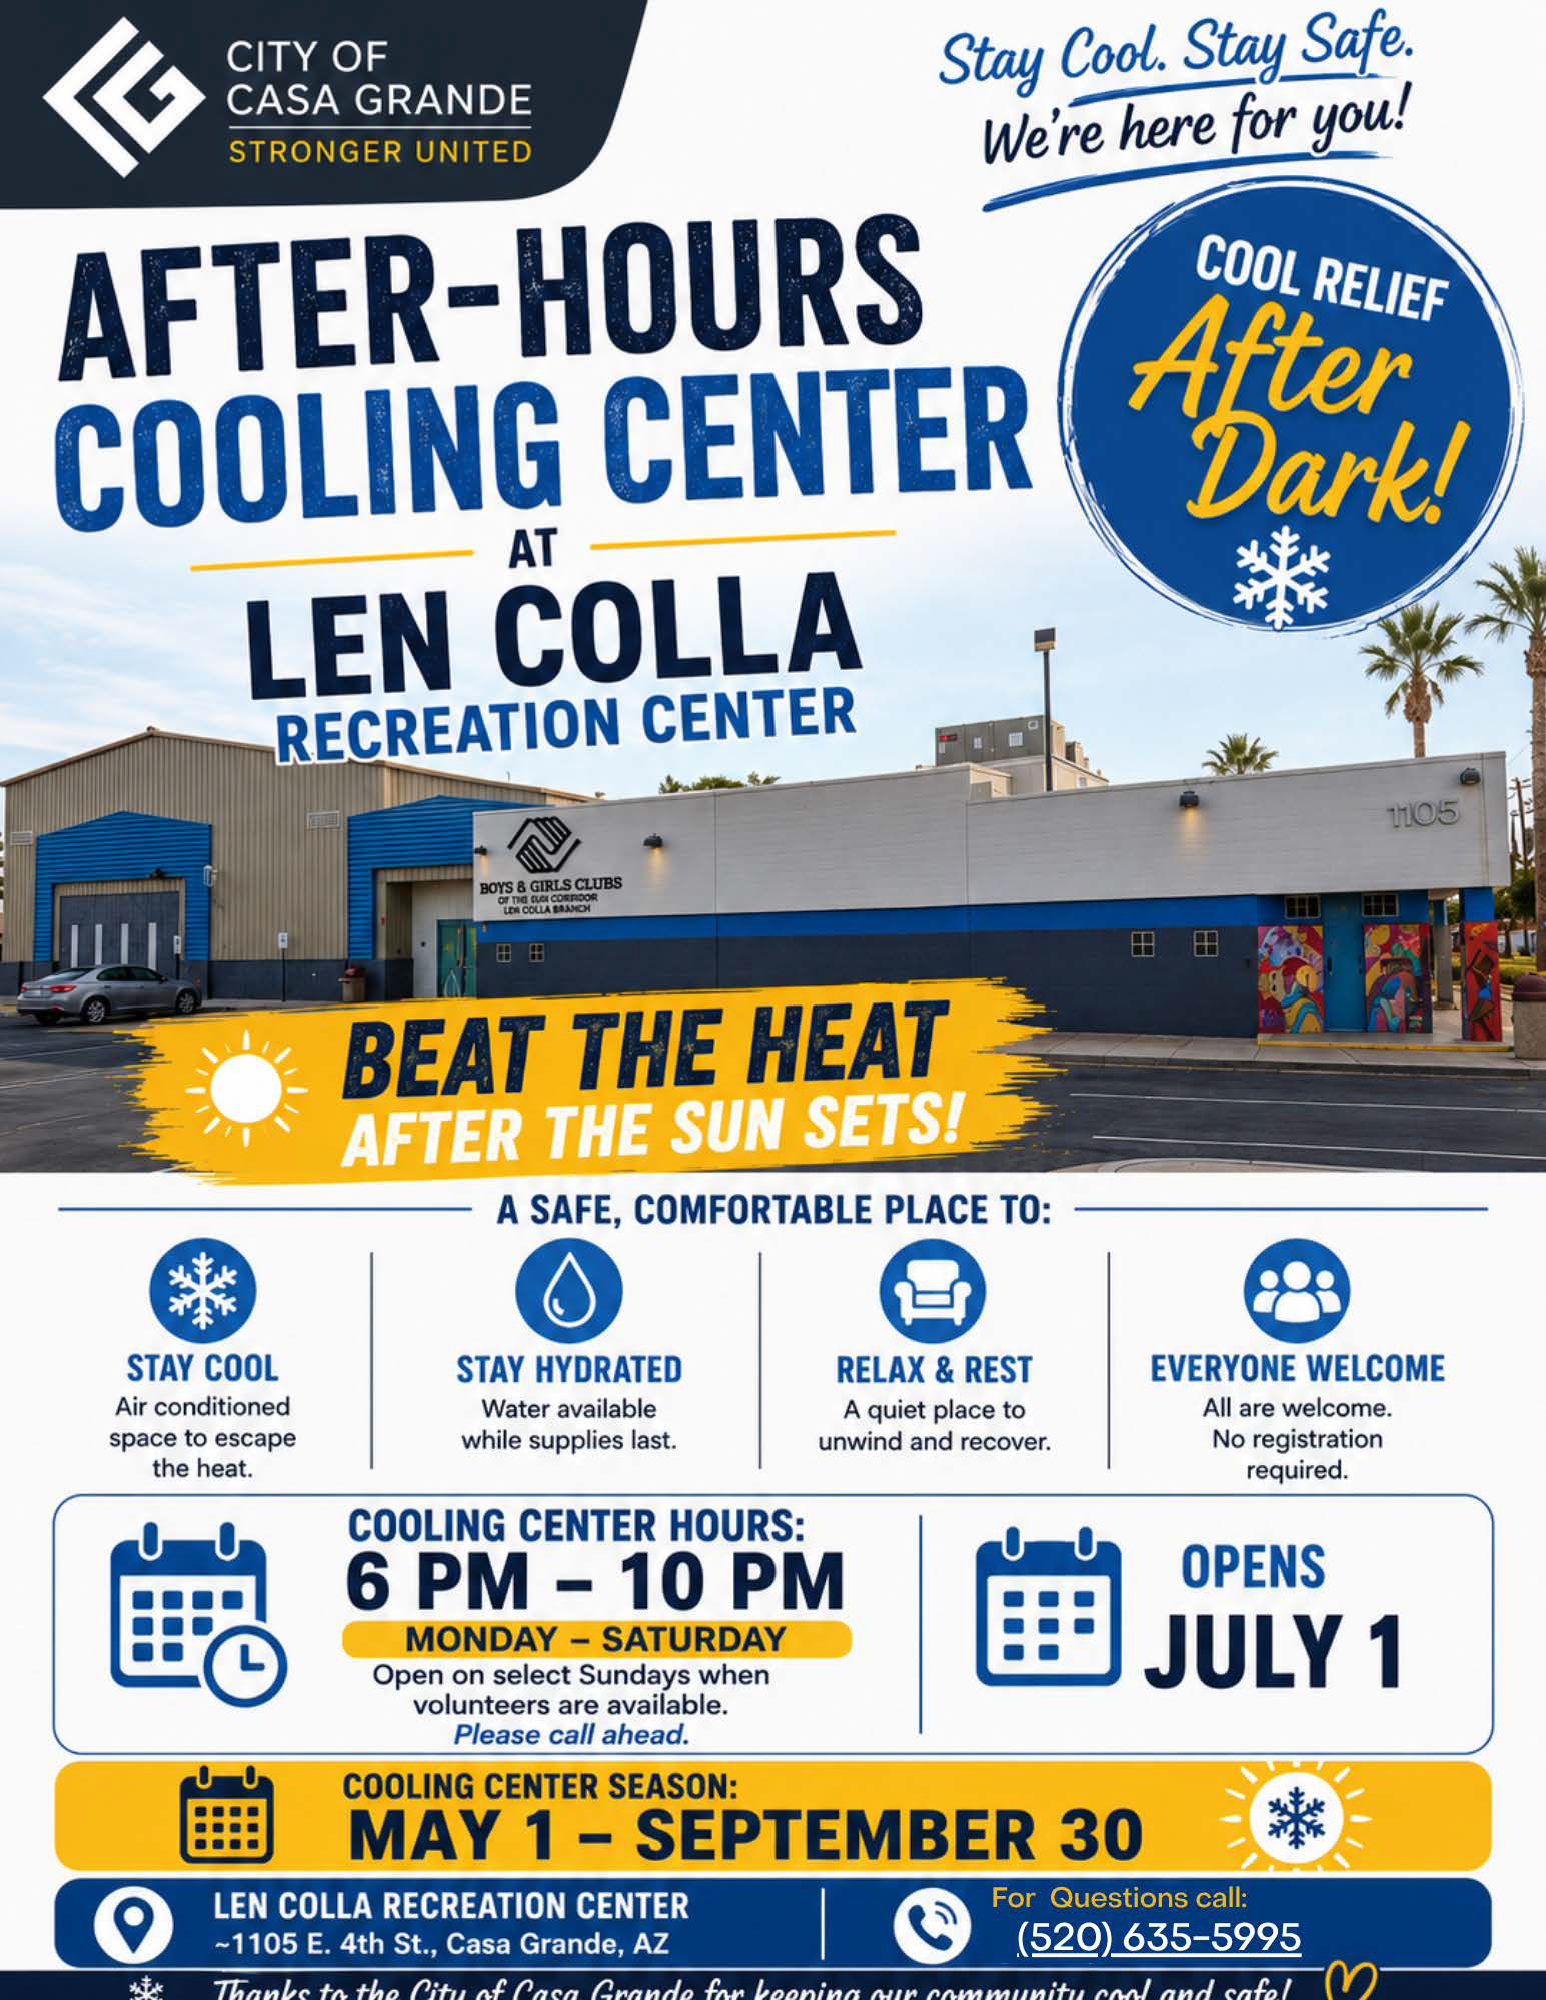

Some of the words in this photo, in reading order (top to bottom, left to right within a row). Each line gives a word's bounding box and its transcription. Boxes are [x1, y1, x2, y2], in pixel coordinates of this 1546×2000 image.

[226, 40, 318, 73] CITY
[332, 40, 388, 73] OF
[939, 33, 1044, 97] Stay
[1060, 23, 1166, 76] Cool.
[1183, 19, 1286, 82] Stay
[1302, 8, 1414, 76] Safe.
[226, 83, 340, 116] CASA
[355, 83, 532, 116] GRANDE
[1119, 103, 1217, 150] here
[1231, 92, 1297, 154] for
[1312, 82, 1413, 154] you!
[229, 139, 401, 163] STRONGER
[416, 139, 532, 163] UNITED
[1195, 233, 1301, 297] COOL
[1314, 258, 1450, 322] RELIEF
[57, 213, 924, 382] AFTER-HOURS
[1128, 293, 1413, 420] After
[54, 380, 562, 533] COOLING
[602, 366, 1034, 505] CENTER
[1186, 409, 1471, 524] Dark!
[508, 527, 558, 569] AT
[246, 590, 452, 701] LEN
[494, 571, 864, 688] COLLA
[277, 697, 620, 763] RECREATION
[643, 685, 857, 744] CENTER
[1387, 799, 1461, 829] 1105
[480, 881, 513, 895] BOYS
[517, 880, 526, 893] &
[530, 879, 572, 892] GIRLS
[575, 876, 623, 890] CLUBS
[341, 1014, 547, 1100] BEAT
[572, 1008, 722, 1091] THE
[746, 999, 951, 1084] HEAT
[339, 1108, 525, 1168] AFTER
[545, 1103, 652, 1158] THE
[669, 1098, 791, 1154] SUN
[803, 1090, 967, 1149] SETS!
[496, 1194, 519, 1225] A
[530, 1193, 621, 1230] SAFE,
[634, 1193, 873, 1225] COMFORTABLE
[885, 1193, 988, 1225] PLACE
[999, 1193, 1051, 1225] TO:
[127, 1353, 194, 1382] STAY
[204, 1353, 279, 1382] COOL
[456, 1354, 525, 1384] STAY
[535, 1355, 682, 1384] HYDRATED
[837, 1355, 925, 1384] RELAX
[934, 1355, 955, 1384] &
[965, 1354, 1034, 1384] REST
[1151, 1353, 1296, 1383] EVERYONE
[1306, 1353, 1445, 1382] WELCOME
[115, 1395, 148, 1417] Air
[154, 1395, 290, 1417] conditioned
[481, 1398, 551, 1419] Water
[557, 1397, 657, 1419] available
[843, 1399, 861, 1420] A
[867, 1398, 927, 1425] quiet
[933, 1398, 996, 1425] place
[1002, 1400, 1026, 1420] to
[1202, 1396, 1232, 1418] All
[1239, 1402, 1275, 1418] are
[1281, 1396, 1392, 1418] welcome.
[109, 1432, 178, 1453] space
[183, 1429, 208, 1448] to
[214, 1432, 297, 1453] escape
[461, 1428, 522, 1450] while
[528, 1429, 624, 1456] supplies
[631, 1428, 677, 1450] last.
[819, 1430, 903, 1452] unwind
[910, 1430, 953, 1452] and
[960, 1435, 1051, 1451] recover.
[1213, 1428, 1246, 1449] No
[1253, 1428, 1383, 1455] registration
[152, 1457, 190, 1478] the
[197, 1457, 253, 1479] heat.
[1247, 1458, 1349, 1485] required.
[348, 1508, 505, 1543] COOLING
[519, 1508, 656, 1543] CENTER
[670, 1508, 804, 1543] HOURS:
[346, 1550, 390, 1611] 6
[418, 1551, 522, 1611] PM
[621, 1550, 704, 1612] 10
[732, 1551, 843, 1610] PM
[1182, 1543, 1326, 1589] OPENS
[406, 1625, 558, 1653] MONDAY
[602, 1625, 787, 1653] SATURDAY
[1144, 1614, 1344, 1690] JULY
[1370, 1614, 1399, 1689] 1
[372, 1663, 443, 1691] Open
[452, 1669, 485, 1686] on
[493, 1663, 571, 1686] select
[579, 1663, 691, 1692] Sundays
[698, 1662, 770, 1686] when
[413, 1692, 551, 1716] volunteers
[558, 1699, 600, 1716] are
[607, 1692, 728, 1716] available.
[453, 1722, 541, 1746] Please
[548, 1722, 596, 1746] call
[601, 1722, 689, 1746] ahead.
[343, 1772, 474, 1800] COOLING
[484, 1772, 598, 1800] CENTER
[608, 1772, 737, 1800] SEASON:
[350, 1808, 502, 1861] MAY
[526, 1808, 551, 1860] 1
[636, 1808, 1036, 1862] SEPTEMBER
[1060, 1808, 1143, 1862] 30
[214, 1891, 268, 1919] LEN
[278, 1891, 373, 1920] COLLA
[383, 1891, 566, 1920] RECREATION
[576, 1891, 689, 1920] CENTER
[992, 1886, 1037, 1908] For
[1050, 1886, 1188, 1909] Questions
[1195, 1885, 1247, 1908] call:
[215, 1932, 298, 1955] ~1105
[307, 1932, 331, 1955] E.
[339, 1931, 384, 1955] 4th
[393, 1931, 438, 1959] St.,
[446, 1932, 511, 1955] Casa
[519, 1931, 625, 1958] Grande,
[632, 1932, 669, 1955] AZ
[1017, 1920, 1114, 1958] (520)
